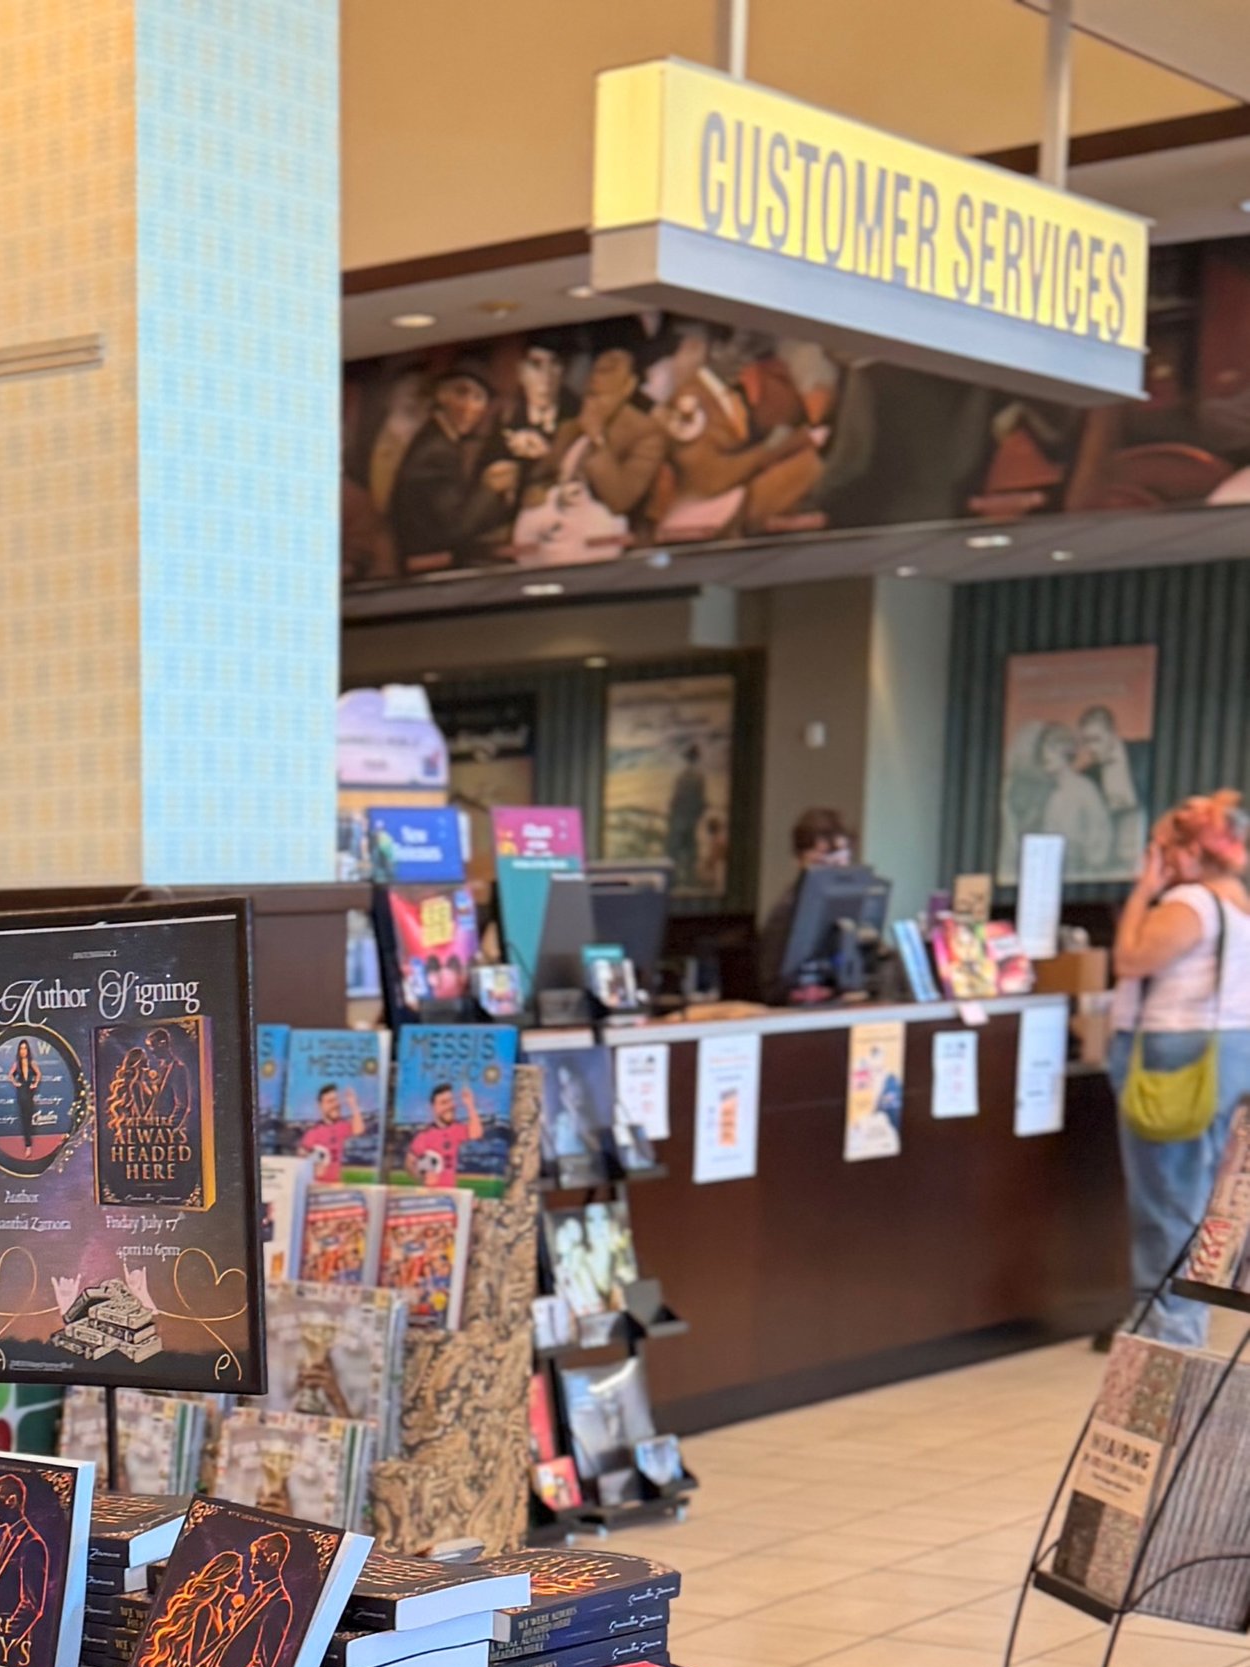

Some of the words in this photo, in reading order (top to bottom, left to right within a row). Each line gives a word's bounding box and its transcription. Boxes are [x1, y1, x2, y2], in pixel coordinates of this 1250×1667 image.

[699, 110, 940, 293] CUSTOMER
[953, 192, 1127, 344] SERVICES
[97, 969, 200, 1020] Signing
[113, 1127, 188, 1145] ALWAYS
[111, 1145, 192, 1163] HEADED
[125, 1163, 177, 1180] HERE
[106, 1214, 139, 1235] Friday
[140, 1214, 163, 1235] July
